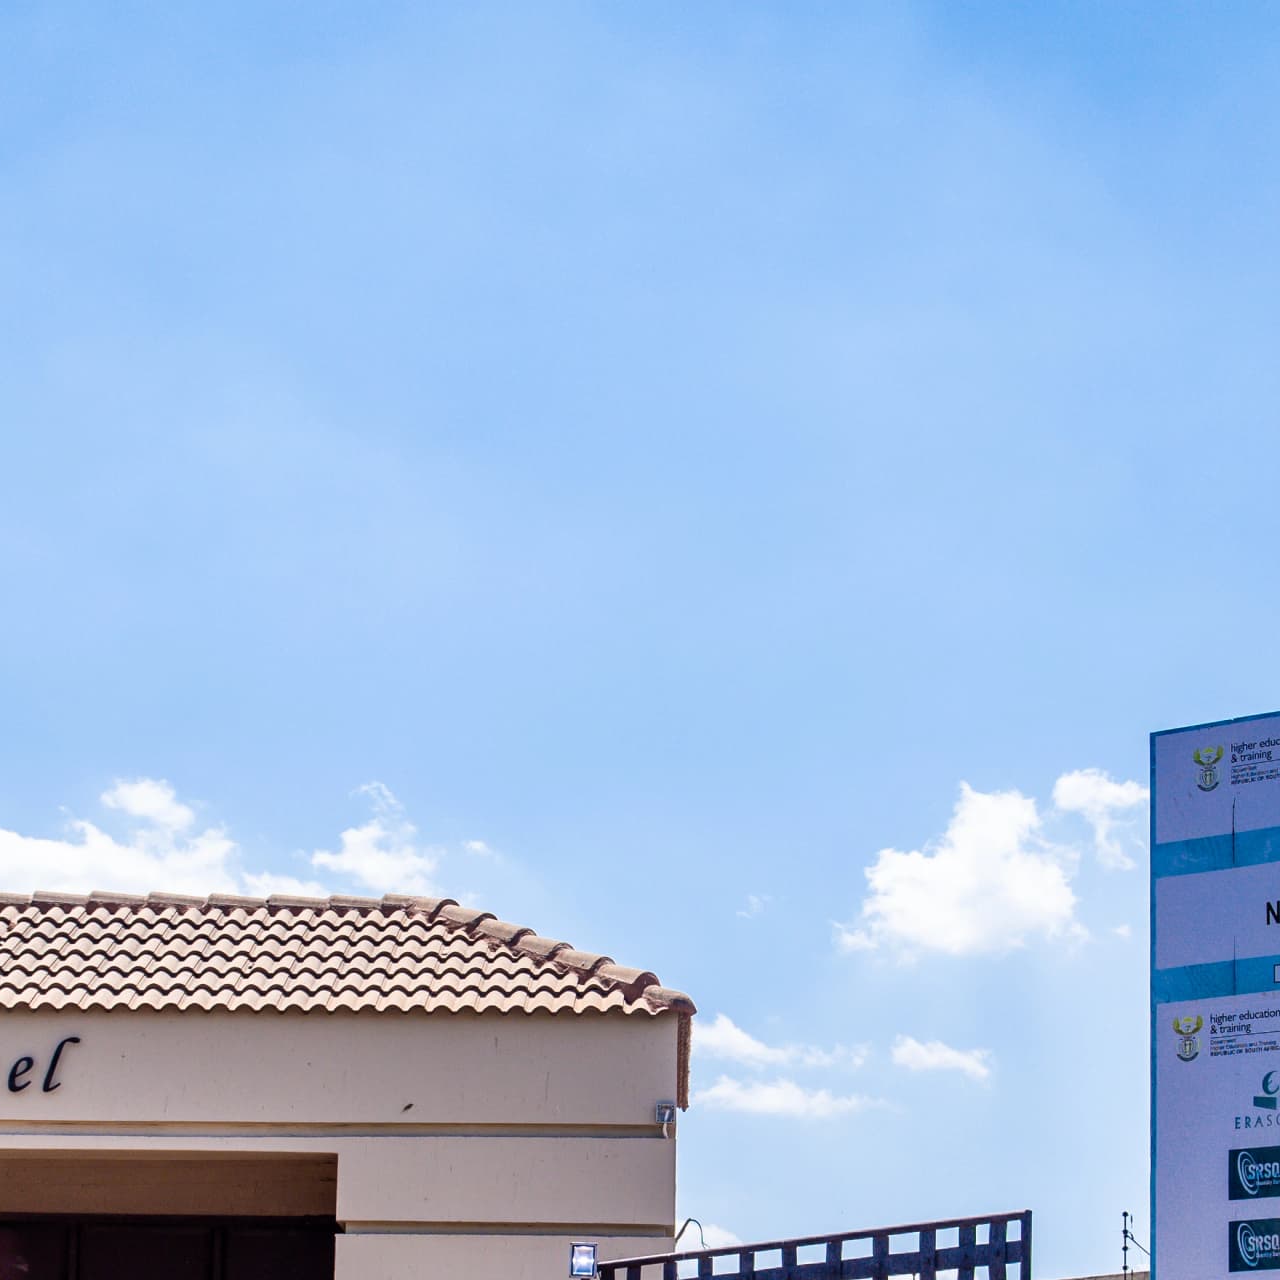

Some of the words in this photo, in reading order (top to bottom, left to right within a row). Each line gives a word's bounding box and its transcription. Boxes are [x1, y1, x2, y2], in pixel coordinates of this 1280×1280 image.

[1230, 742, 1257, 754] higher
[1230, 754, 1237, 763] &
[1240, 750, 1272, 761] training
[1209, 1014, 1237, 1025] higher
[1239, 1008, 1280, 1020] education
[1210, 1025, 1218, 1034] &
[1219, 1022, 1251, 1034] training
